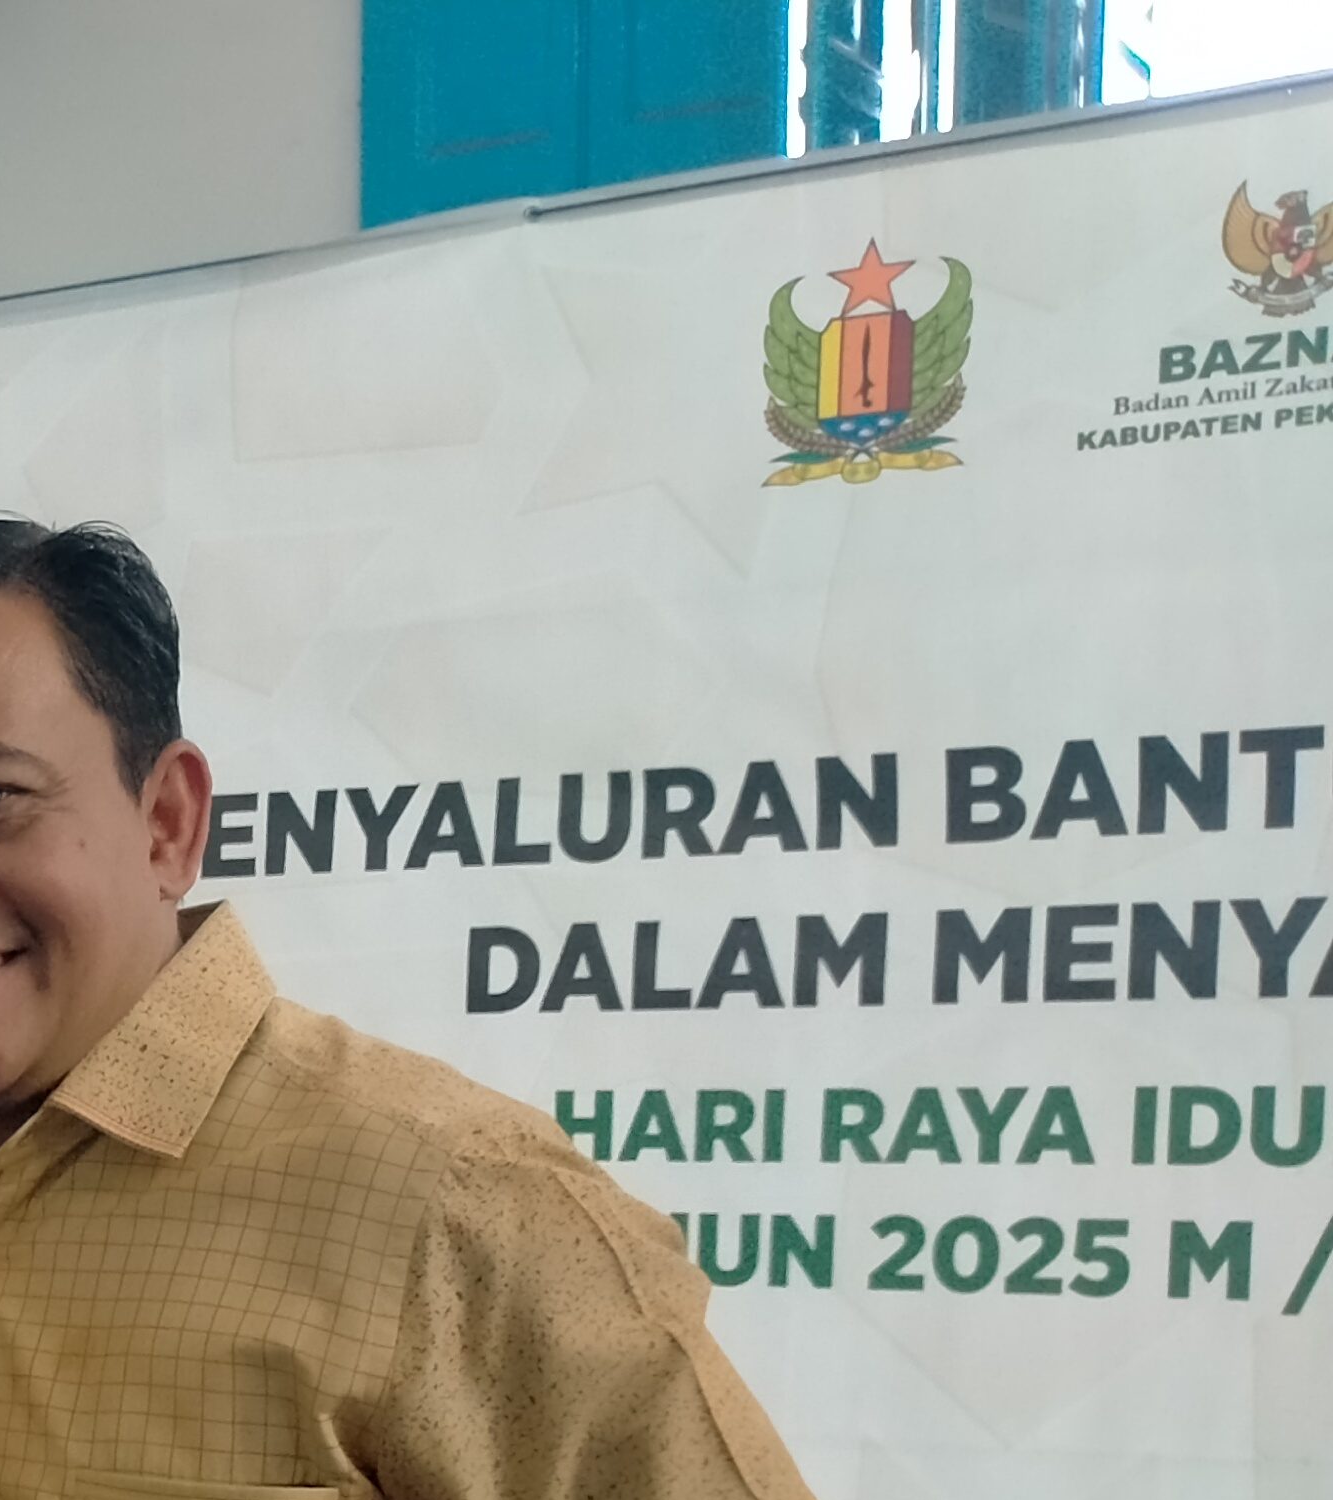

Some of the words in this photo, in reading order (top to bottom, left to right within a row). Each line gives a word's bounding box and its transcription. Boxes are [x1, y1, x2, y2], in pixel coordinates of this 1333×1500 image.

[1158, 326, 1333, 384] BAZN
[1077, 412, 1262, 451] KABUPATEN
[1113, 393, 1190, 416] Badan
[1197, 381, 1256, 406] Amil
[201, 752, 899, 879] ENYALURAN
[944, 724, 1333, 845] BANT
[465, 911, 889, 1015] DALAM
[554, 1088, 787, 1163] HARI
[820, 1085, 1096, 1165] RAYA
[671, 1212, 836, 1289] UN
[867, 1214, 1130, 1298] 2025
[1167, 1220, 1254, 1301] M
